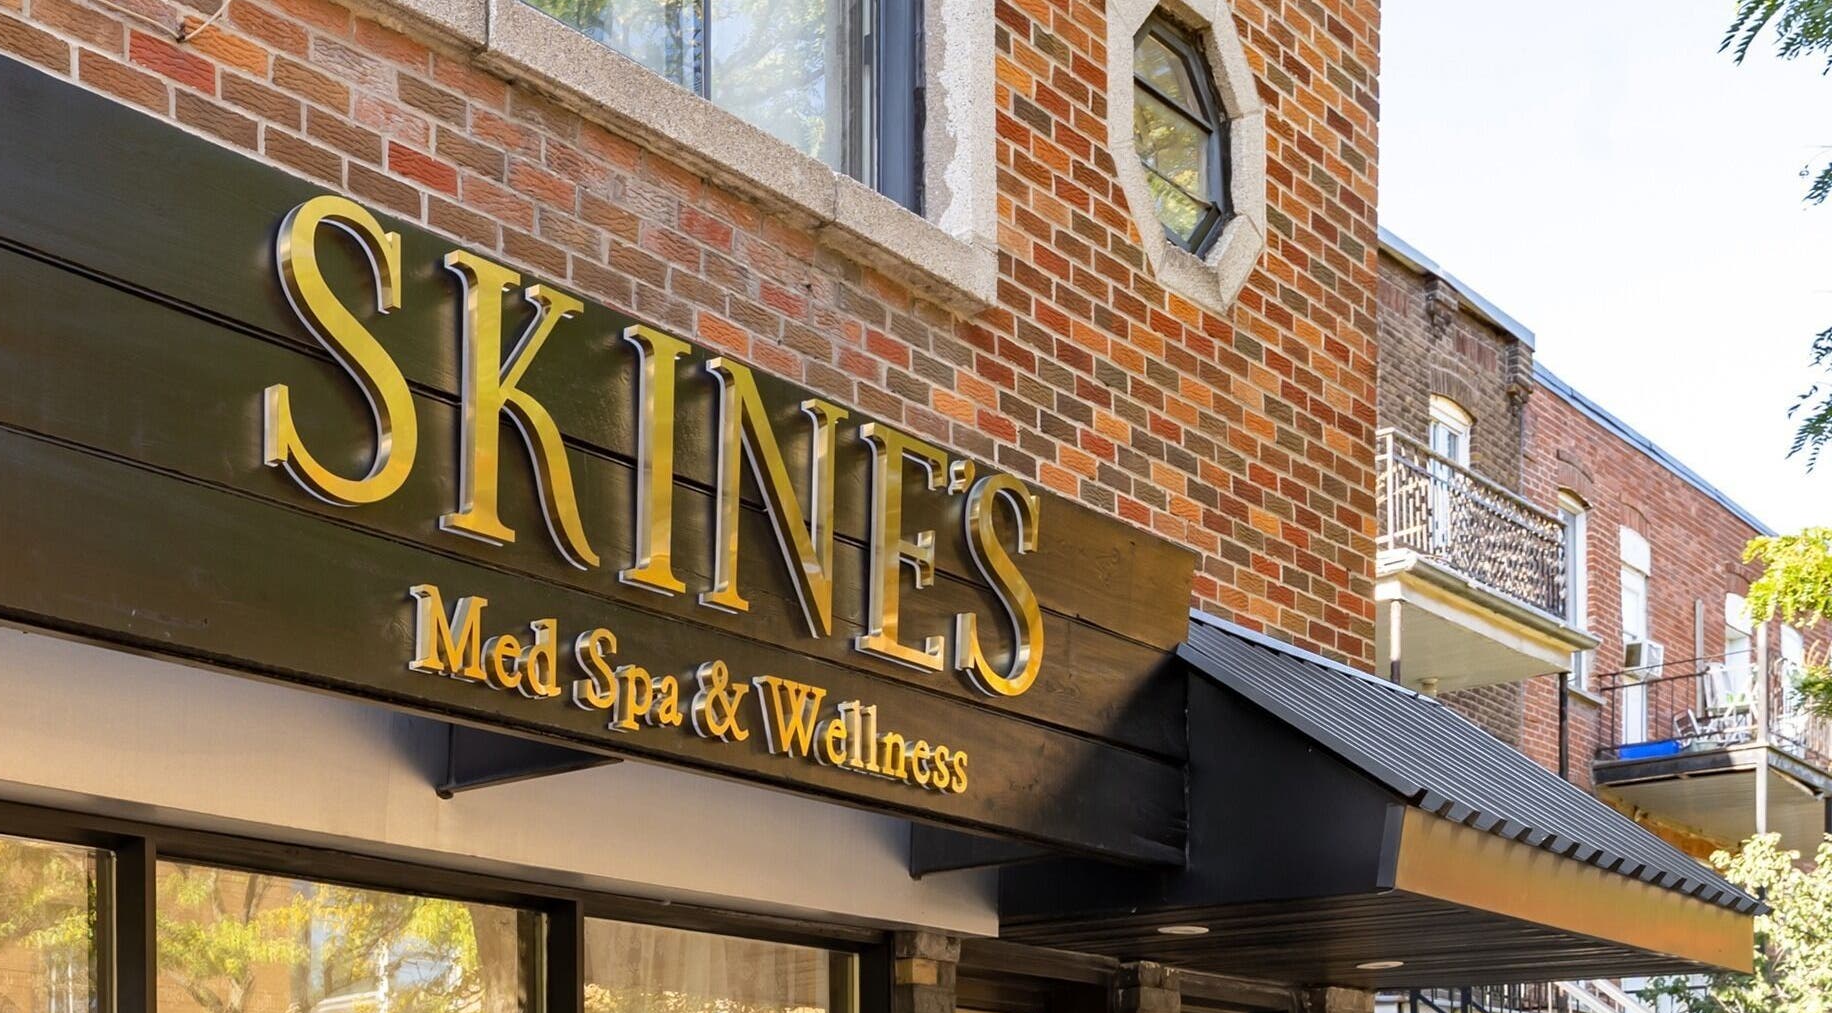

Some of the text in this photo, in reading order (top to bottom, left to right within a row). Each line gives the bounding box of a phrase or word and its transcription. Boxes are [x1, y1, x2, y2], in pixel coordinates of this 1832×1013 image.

[263, 195, 1045, 700] SKINE'S
[409, 584, 968, 794] Med Spa & Wellness
